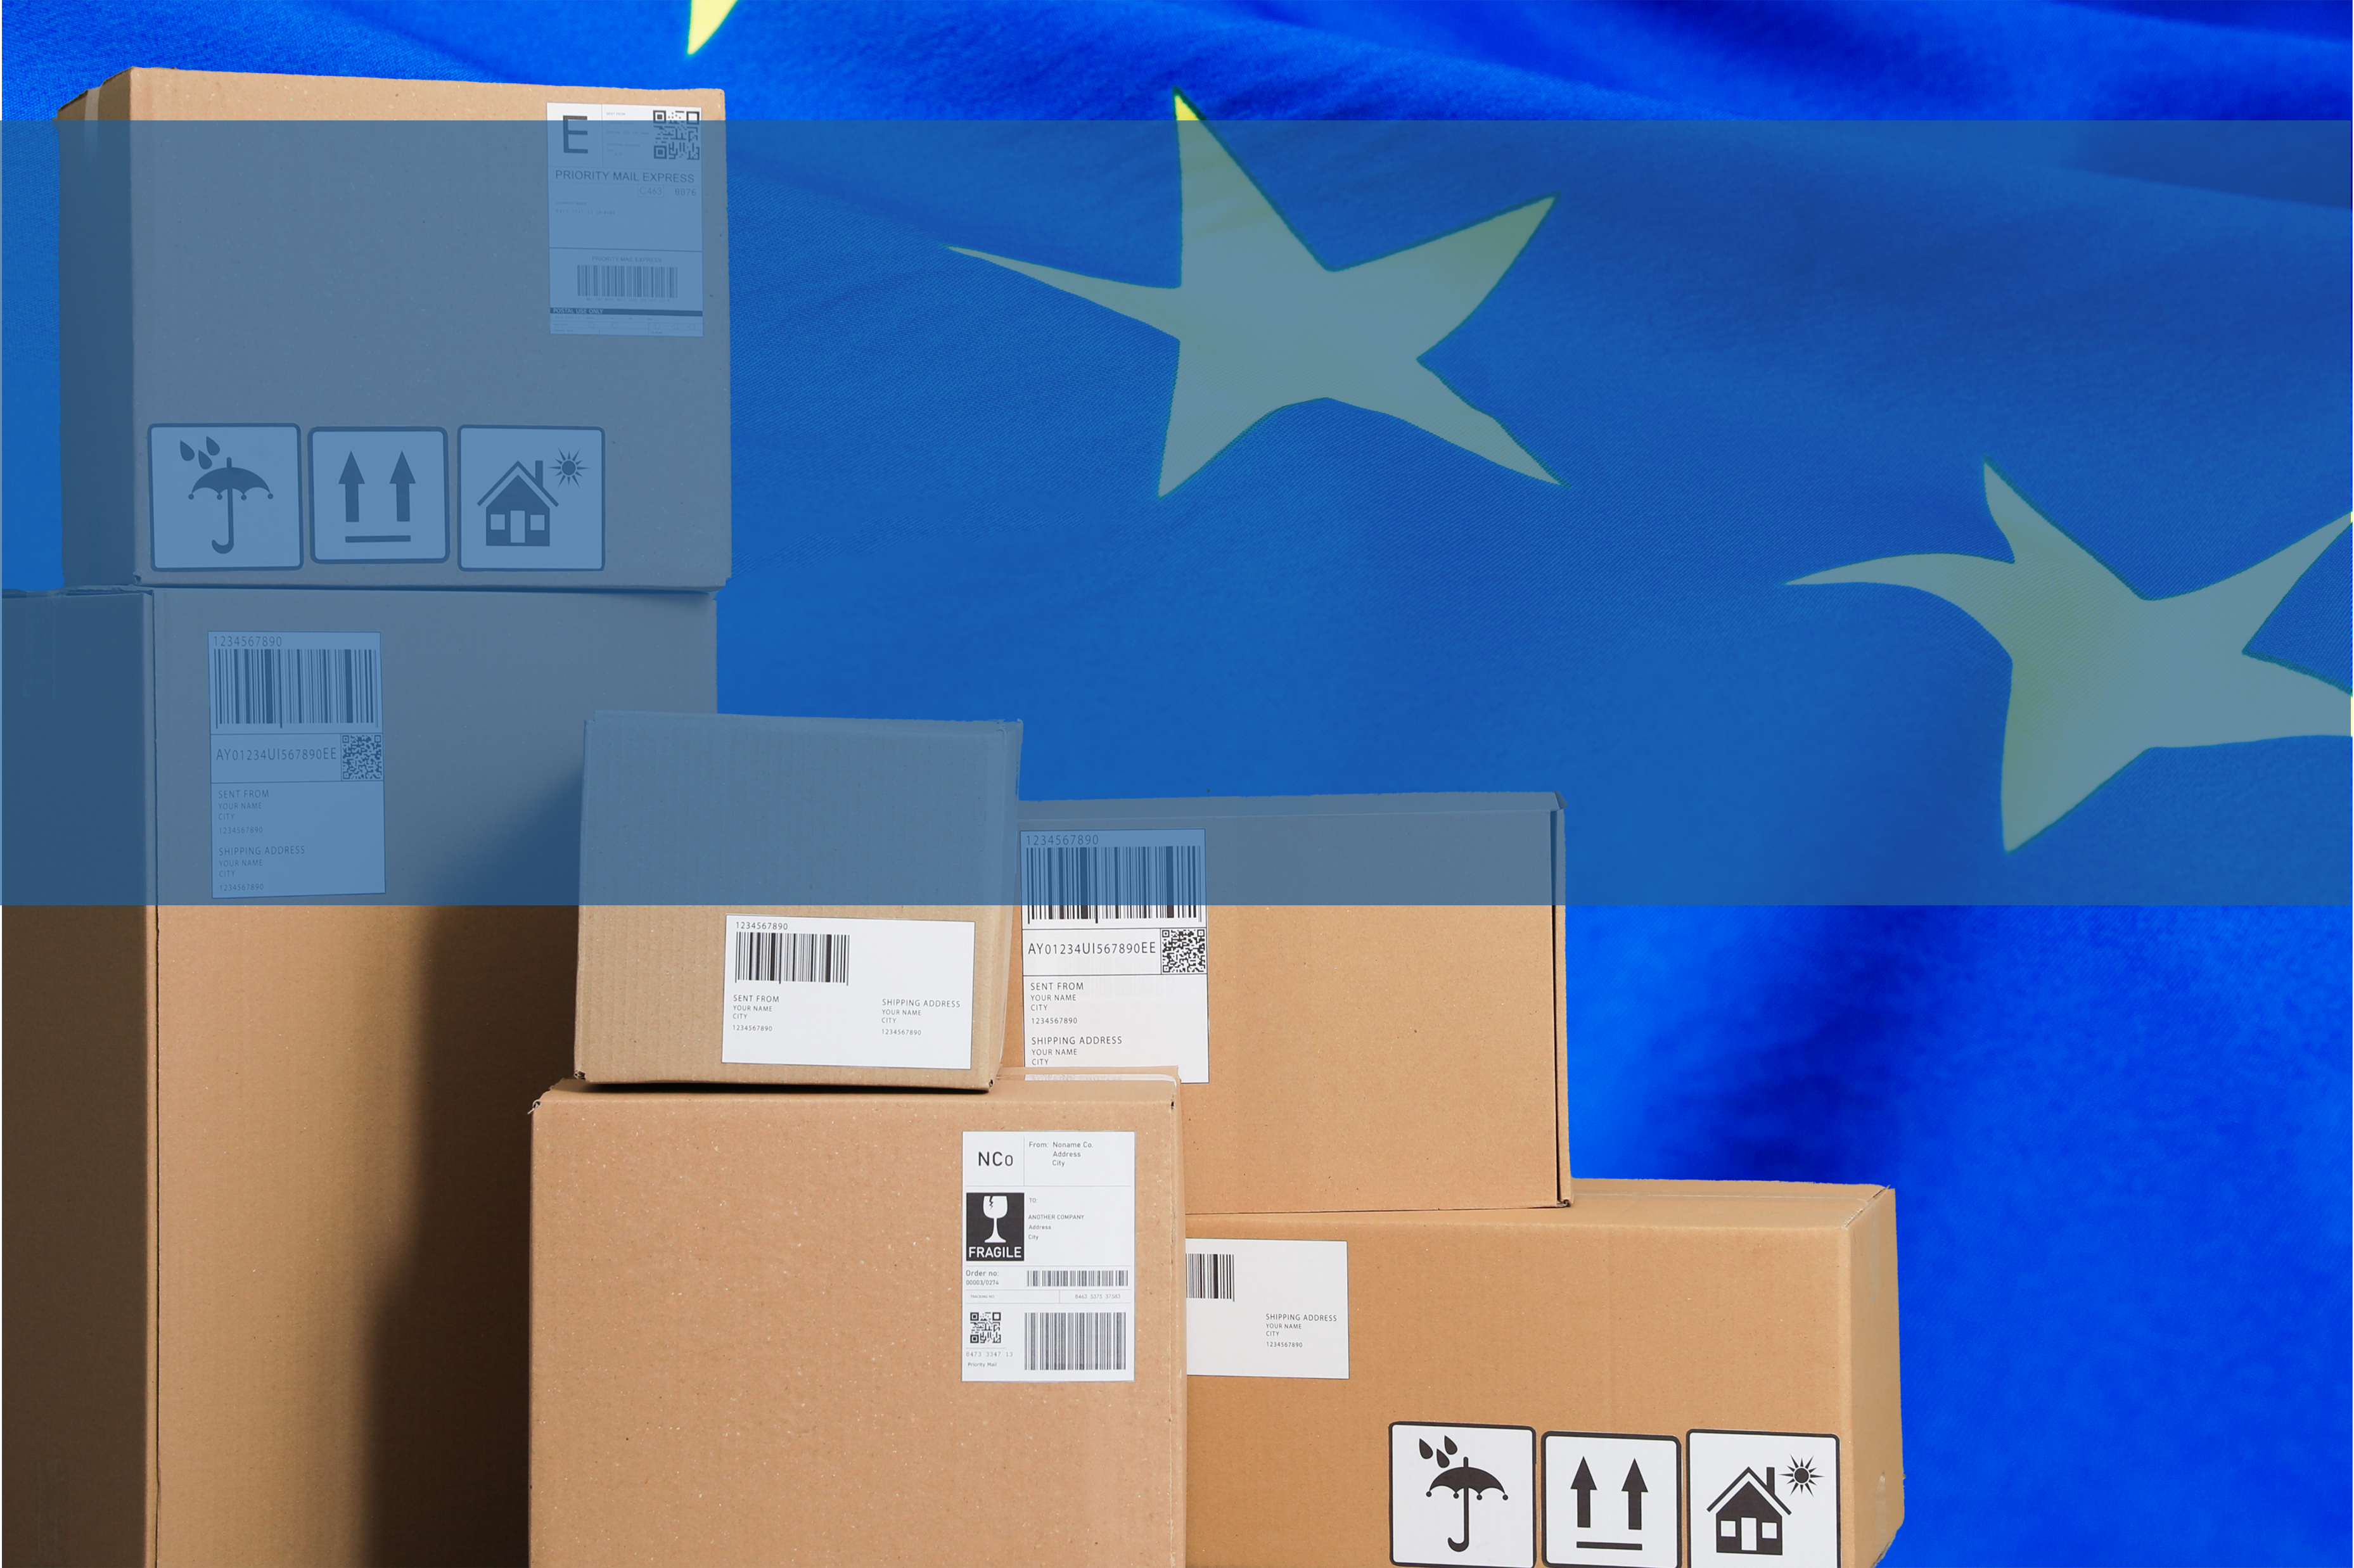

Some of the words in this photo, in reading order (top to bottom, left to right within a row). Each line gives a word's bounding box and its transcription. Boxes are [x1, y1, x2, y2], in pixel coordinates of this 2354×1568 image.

[563, 115, 587, 153] E
[556, 170, 609, 180] PRIORITY
[613, 172, 639, 181] MAIL
[643, 172, 694, 183] EXPRESS
[639, 186, 663, 196] C463
[214, 636, 281, 647] 1234567890
[216, 748, 336, 760] AY01234UI567890EE
[219, 790, 240, 798] SENT
[244, 789, 269, 798] FROM
[1027, 834, 1098, 845] 1234567890
[219, 846, 260, 856] SHIPPING
[265, 846, 305, 855] ADDRESS
[220, 883, 264, 891] 1234567890
[736, 922, 788, 930] 1234567890
[1028, 942, 1155, 954] AY01234UI567890EE
[883, 998, 920, 1007] SHIPPING
[1032, 1036, 1075, 1045] SHIPPING
[1080, 1036, 1122, 1044] ADDRESS
[978, 1152, 1013, 1166] NCo
[969, 1247, 1021, 1258] FRAGILE
